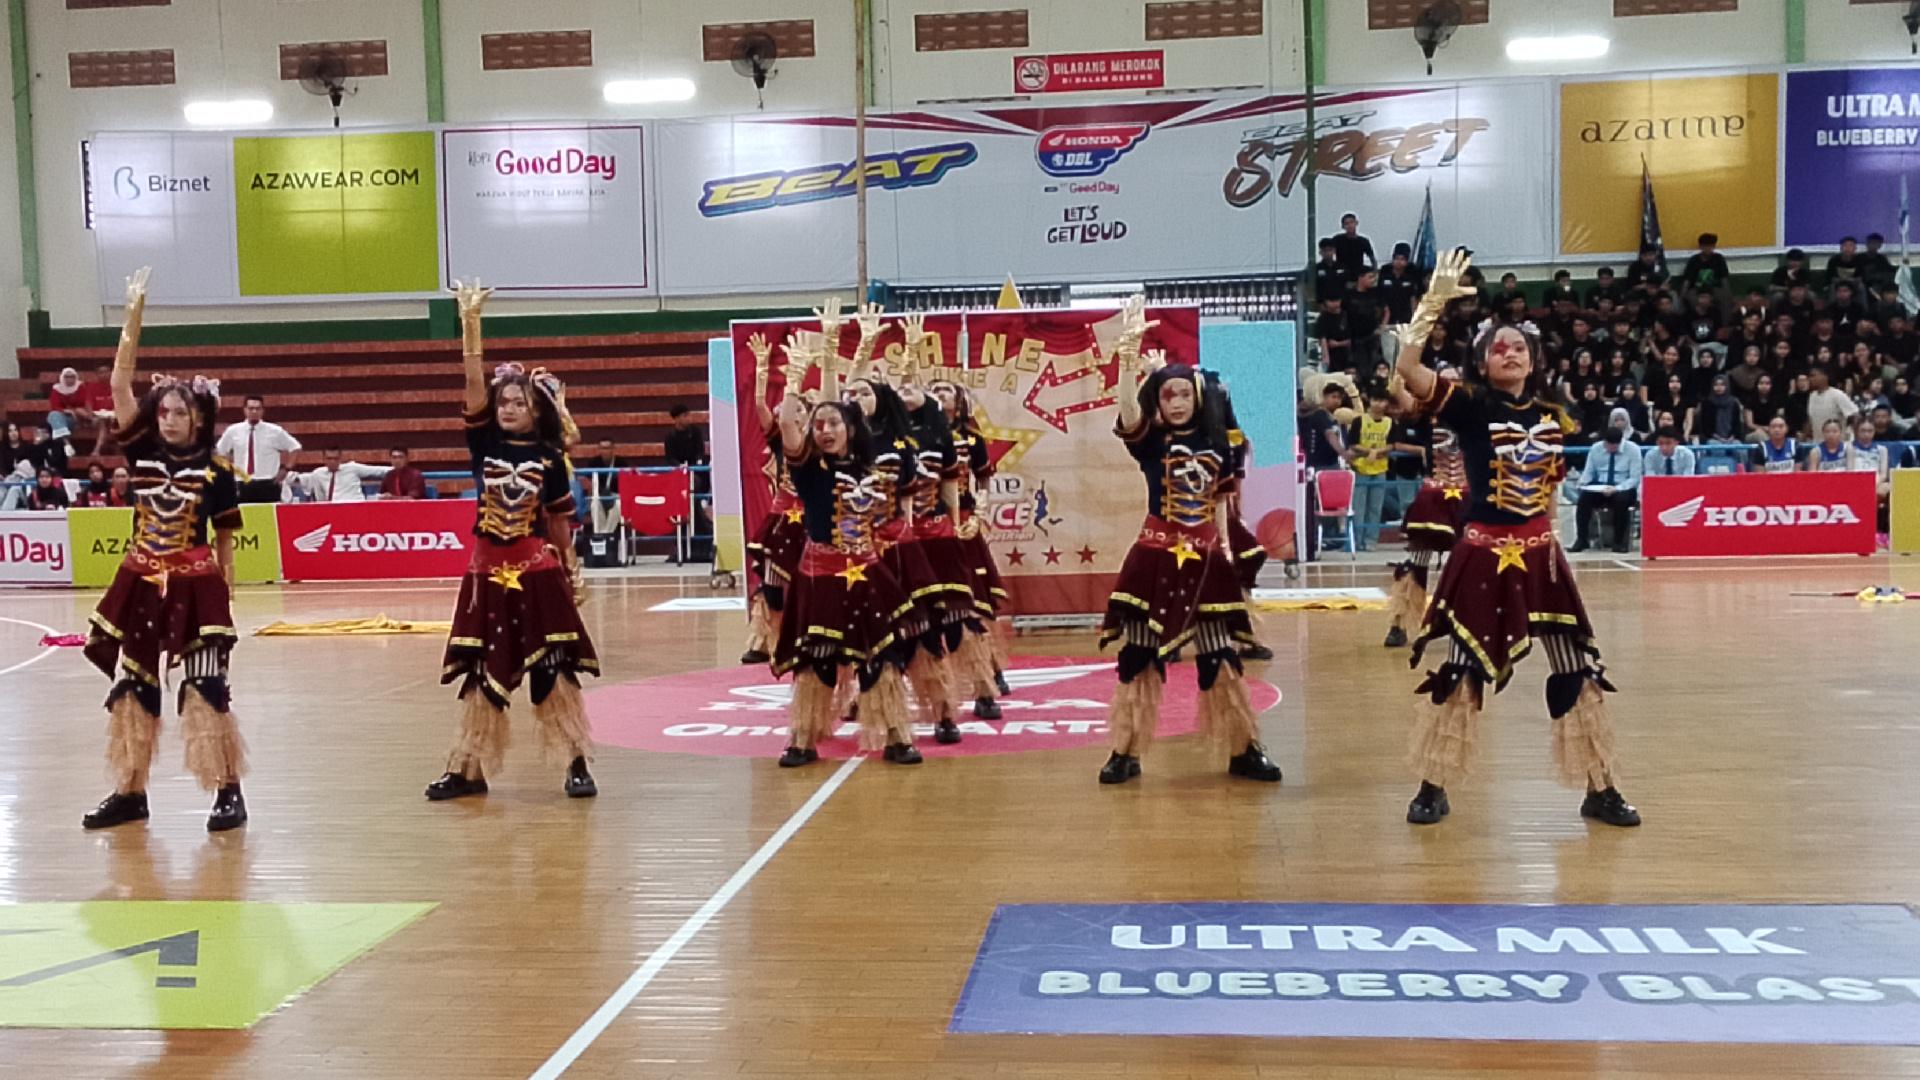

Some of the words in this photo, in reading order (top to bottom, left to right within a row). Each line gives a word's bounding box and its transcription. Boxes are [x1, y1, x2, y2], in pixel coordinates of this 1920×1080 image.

[1053, 61, 1106, 75] DILARANG
[1111, 58, 1160, 72] MEROKOK
[1827, 94, 1905, 117] ULTRA
[1064, 136, 1123, 146] HONDA
[1816, 128, 1919, 146] BLUEBERRY
[1223, 117, 1491, 208] STREET
[148, 175, 211, 192] Biznet
[251, 168, 419, 190] AZAWEAR.COM
[702, 145, 974, 211] BEAT
[1064, 205, 1099, 222] LET'S
[1047, 225, 1079, 244] GET
[1079, 221, 1128, 244] LOUD
[1703, 503, 1861, 527] HONDA
[332, 531, 465, 552] HONDA
[1110, 924, 1478, 952] ULTRA
[1496, 926, 1808, 954] MILK
[1037, 970, 1569, 1000] BLUEBERRY
